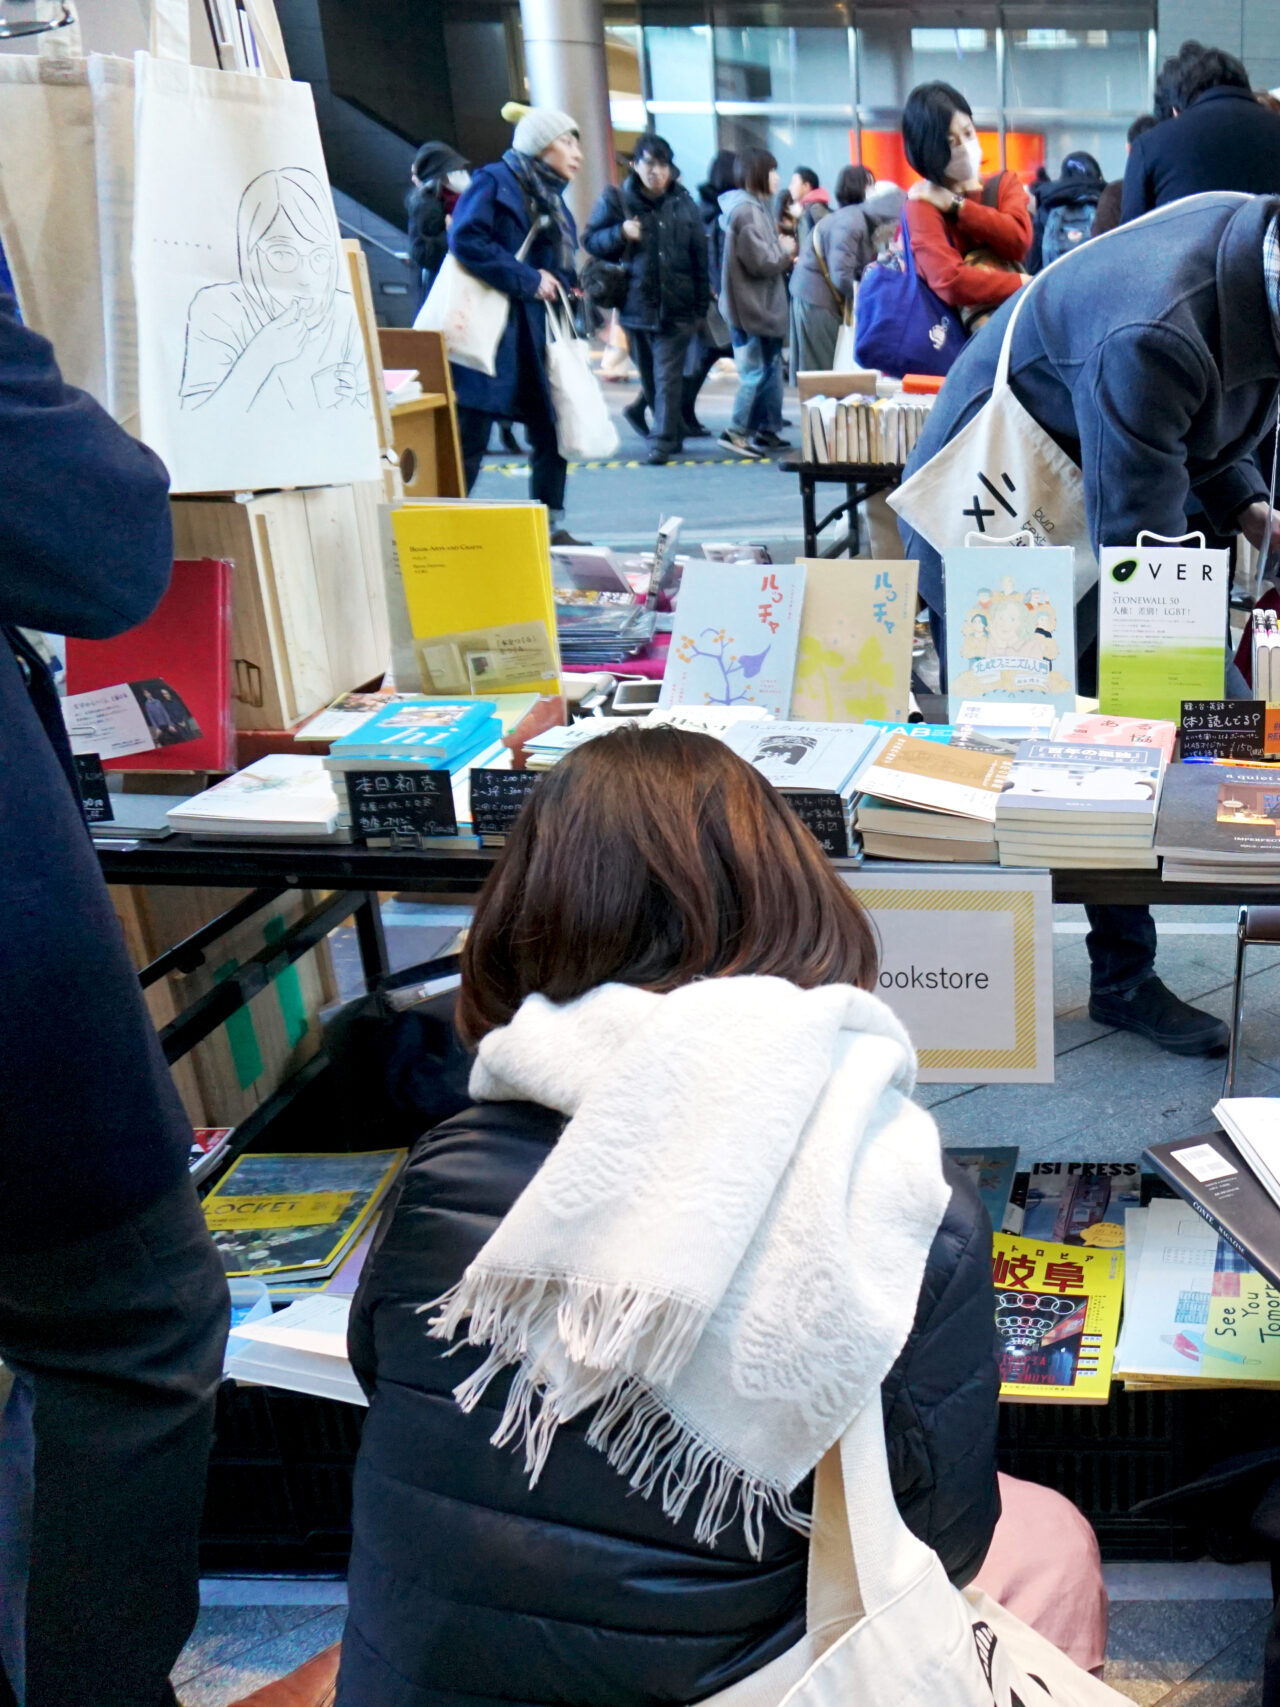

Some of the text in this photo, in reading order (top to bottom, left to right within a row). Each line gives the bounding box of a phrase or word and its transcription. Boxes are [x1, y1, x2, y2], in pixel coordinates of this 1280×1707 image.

[1112, 595, 1168, 605] STONEWALL
[1237, 773, 1274, 782] quiet
[880, 965, 989, 990] ookstore
[1032, 1161, 1138, 1177] ISI PRESS
[1218, 1225, 1246, 1255] MAGAZINE
[1011, 1244, 1094, 1262] トロピア
[992, 1250, 1085, 1293] 岐阜
[1241, 1291, 1260, 1318] You
[1214, 1306, 1237, 1337] See
